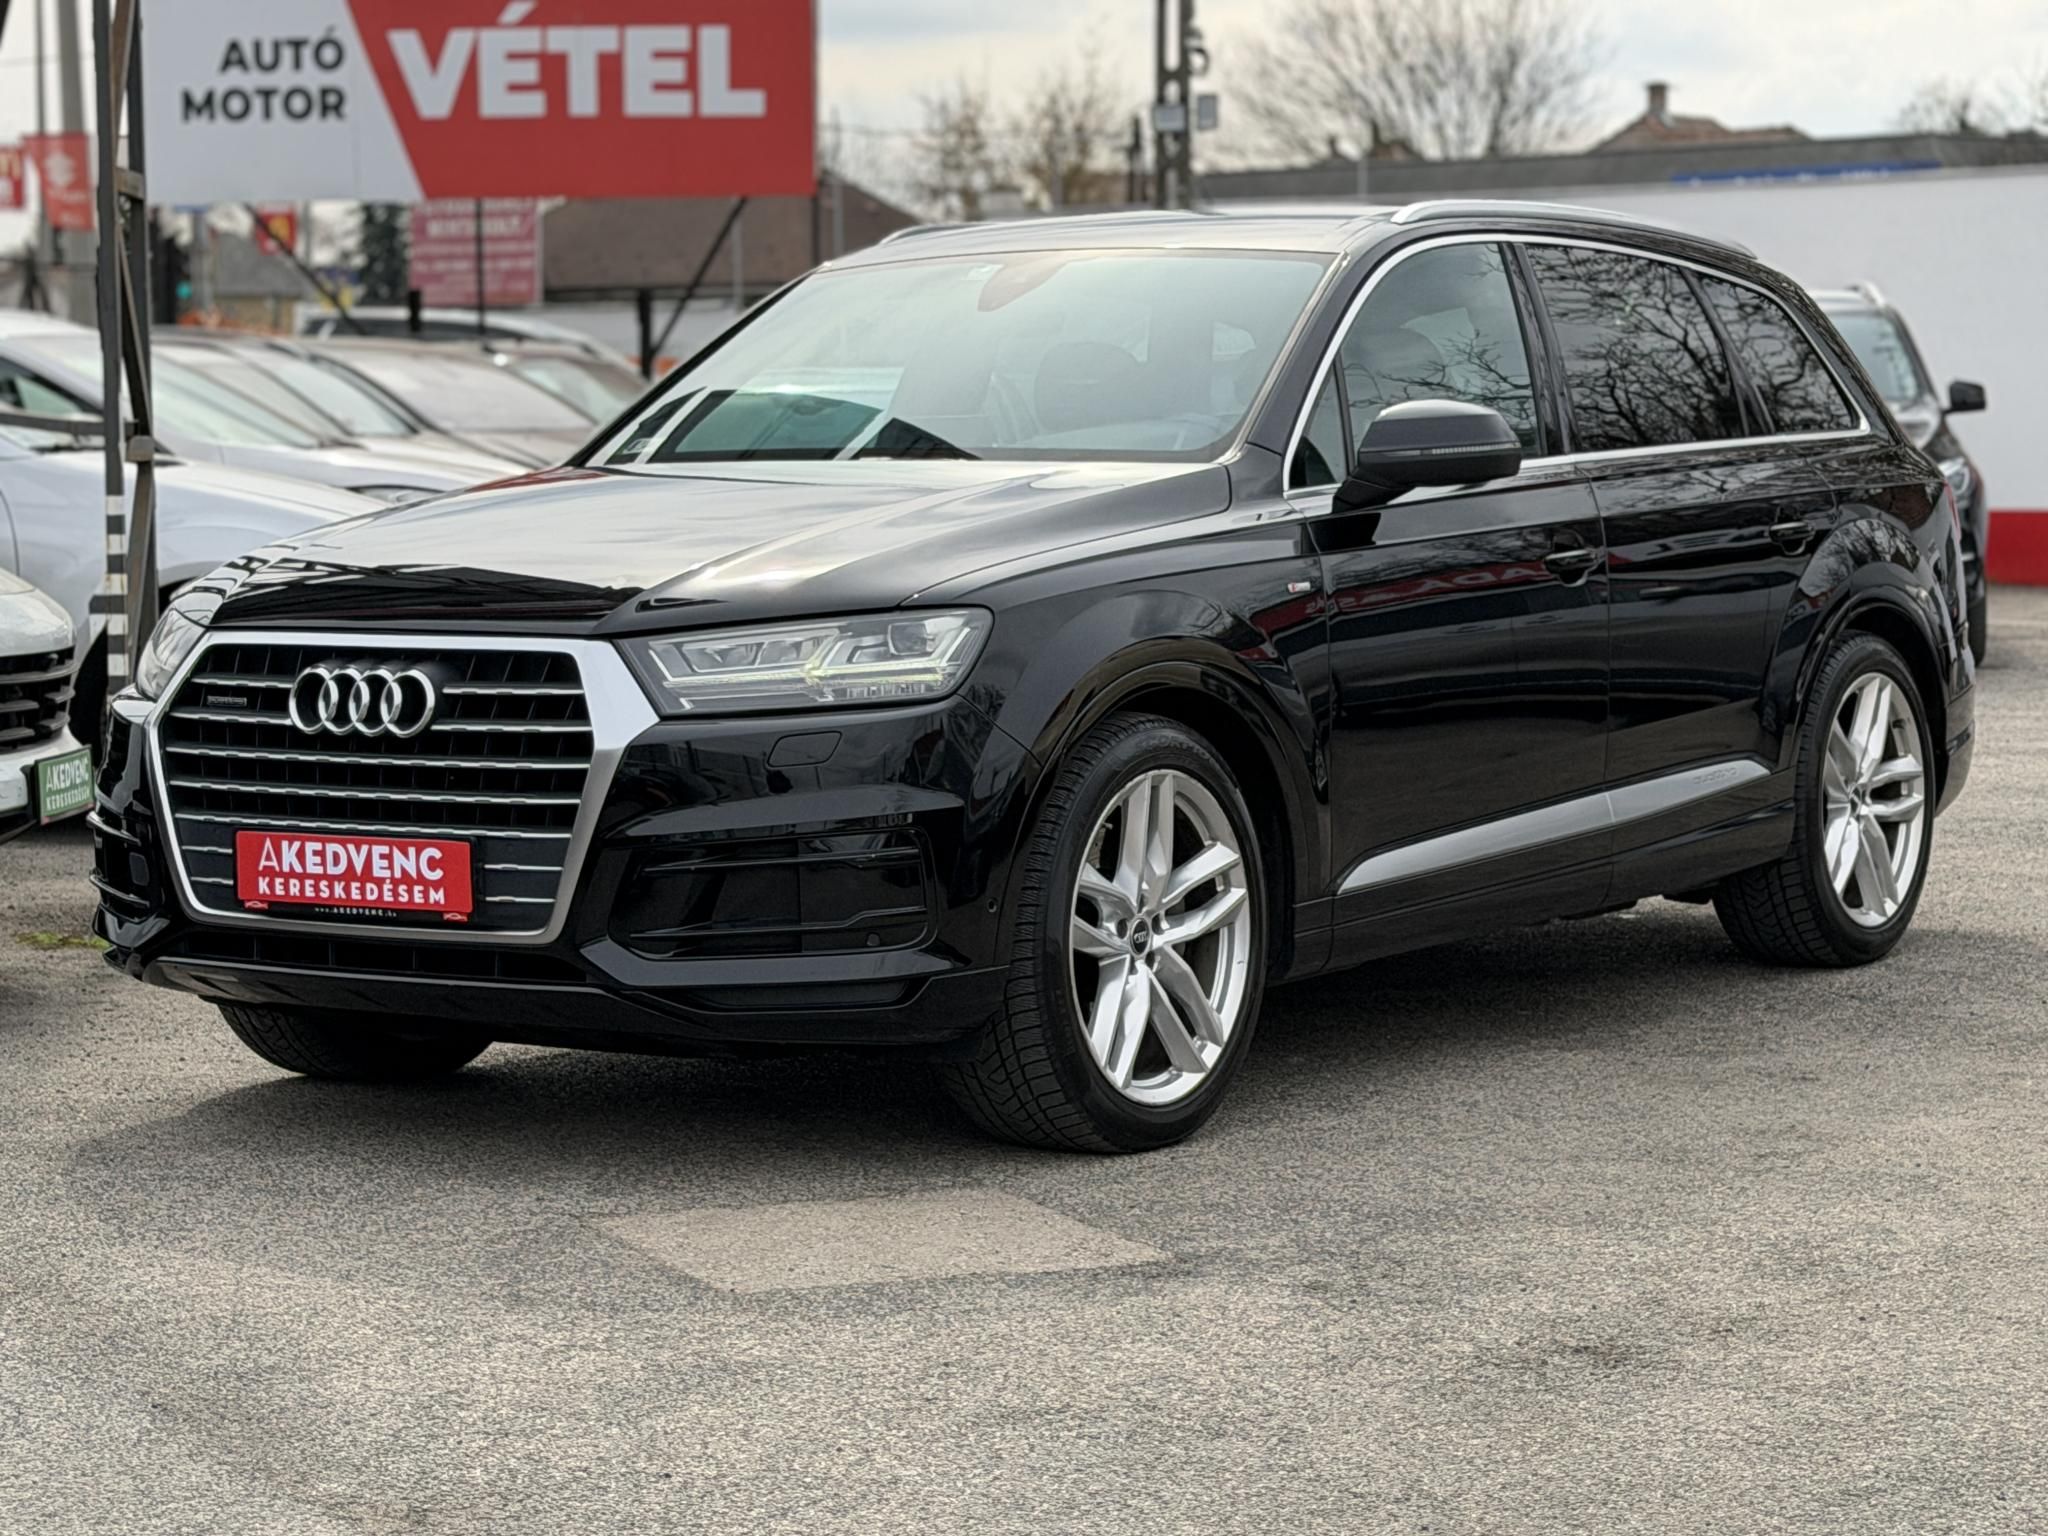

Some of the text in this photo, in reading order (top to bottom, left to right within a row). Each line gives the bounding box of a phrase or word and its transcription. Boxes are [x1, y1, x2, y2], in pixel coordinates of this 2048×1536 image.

[220, 25, 344, 73] AUTÓ
[386, 0, 767, 120] VÉTEL
[181, 86, 347, 122] MOTOR
[46, 757, 89, 792] AKEDVENC
[258, 836, 445, 881] AKEDVENC
[258, 876, 446, 905] KERESKEDÉSEM
